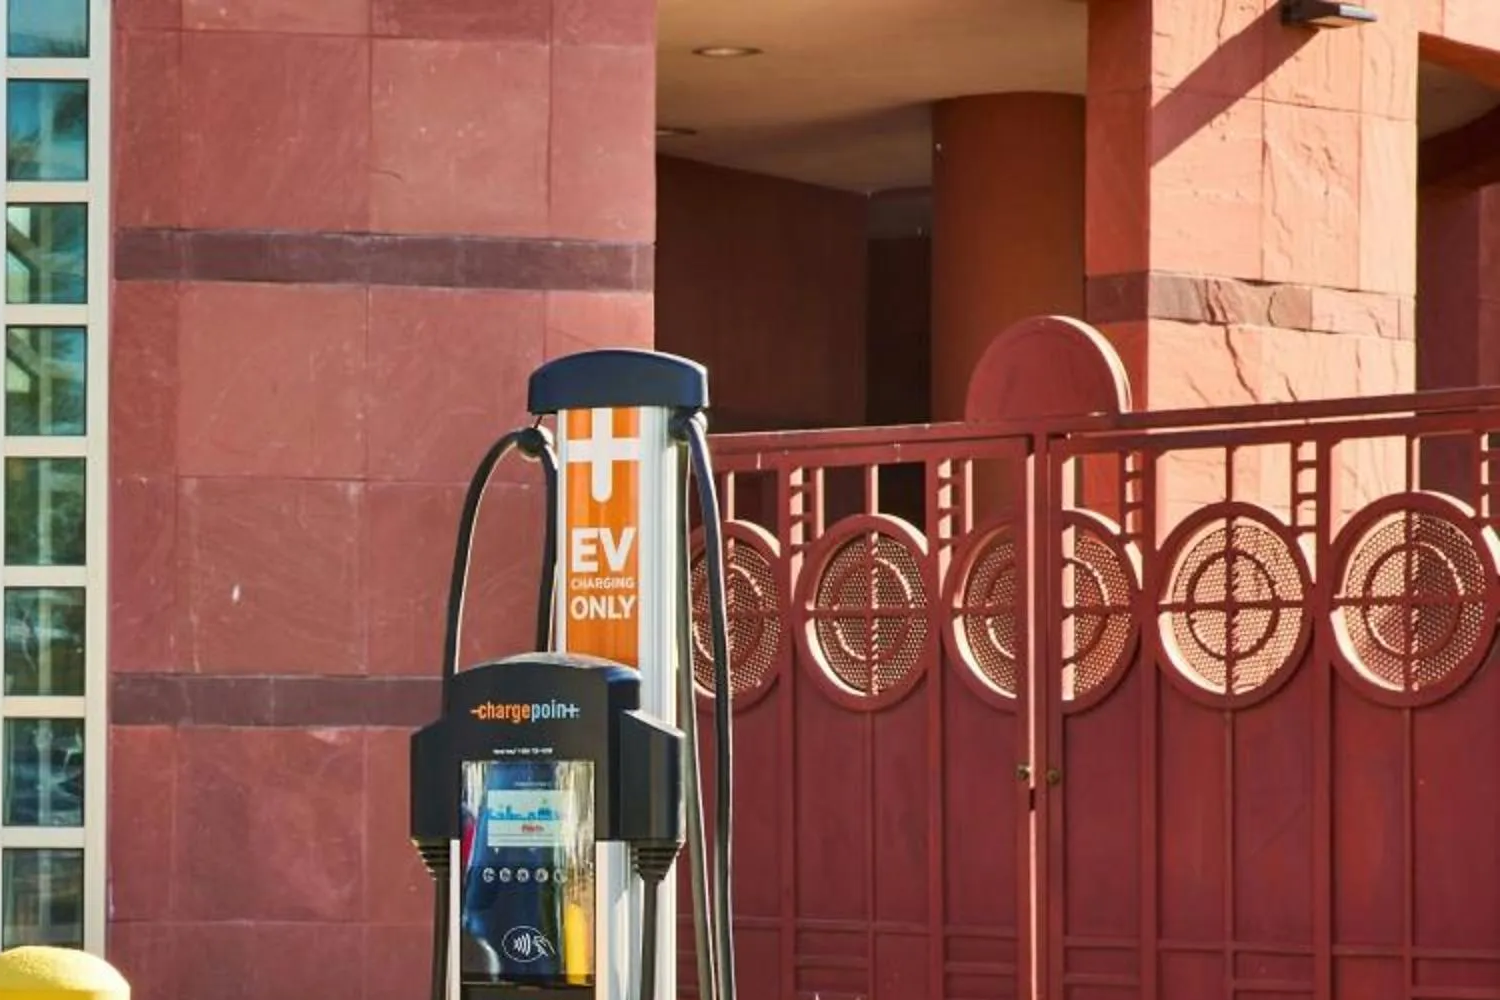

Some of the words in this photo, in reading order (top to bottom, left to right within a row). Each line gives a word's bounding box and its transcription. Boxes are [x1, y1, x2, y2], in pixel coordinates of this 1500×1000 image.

[571, 527, 637, 573] EV
[571, 577, 635, 591] CHARGING
[571, 595, 636, 620] ONLY
